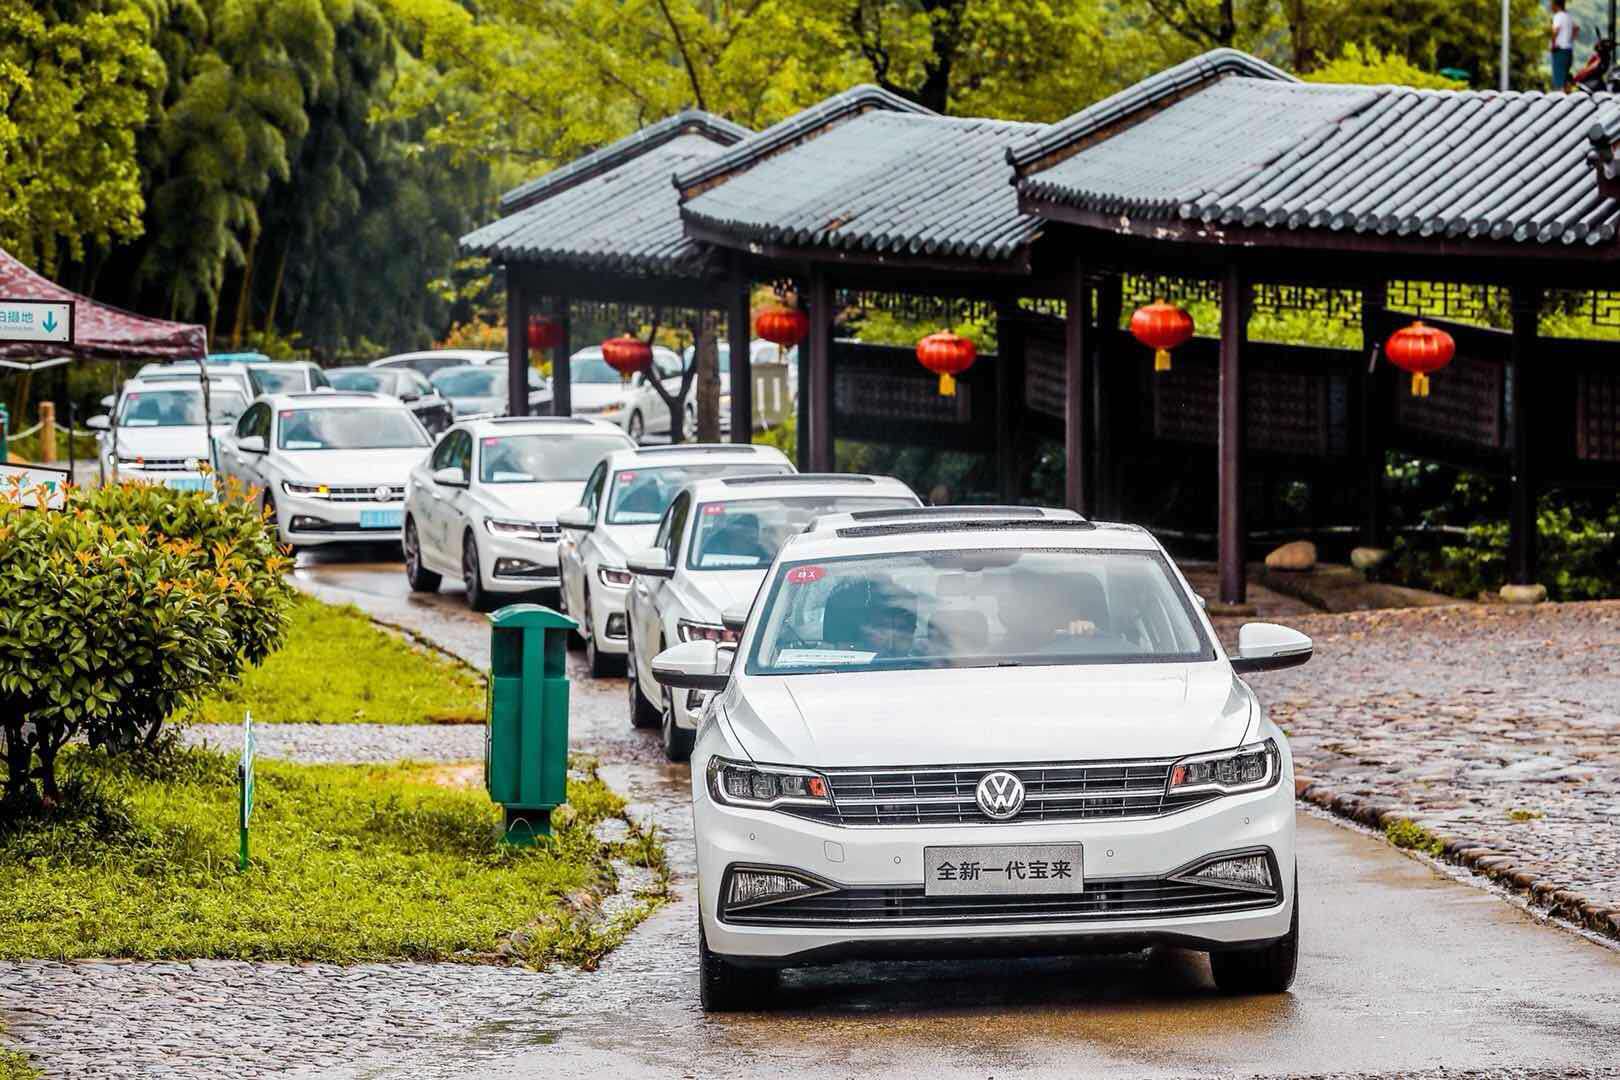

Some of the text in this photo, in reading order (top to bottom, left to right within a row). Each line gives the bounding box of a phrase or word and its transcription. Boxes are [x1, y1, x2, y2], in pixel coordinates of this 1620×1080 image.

[936, 860, 1072, 881] 全新一代宝来
